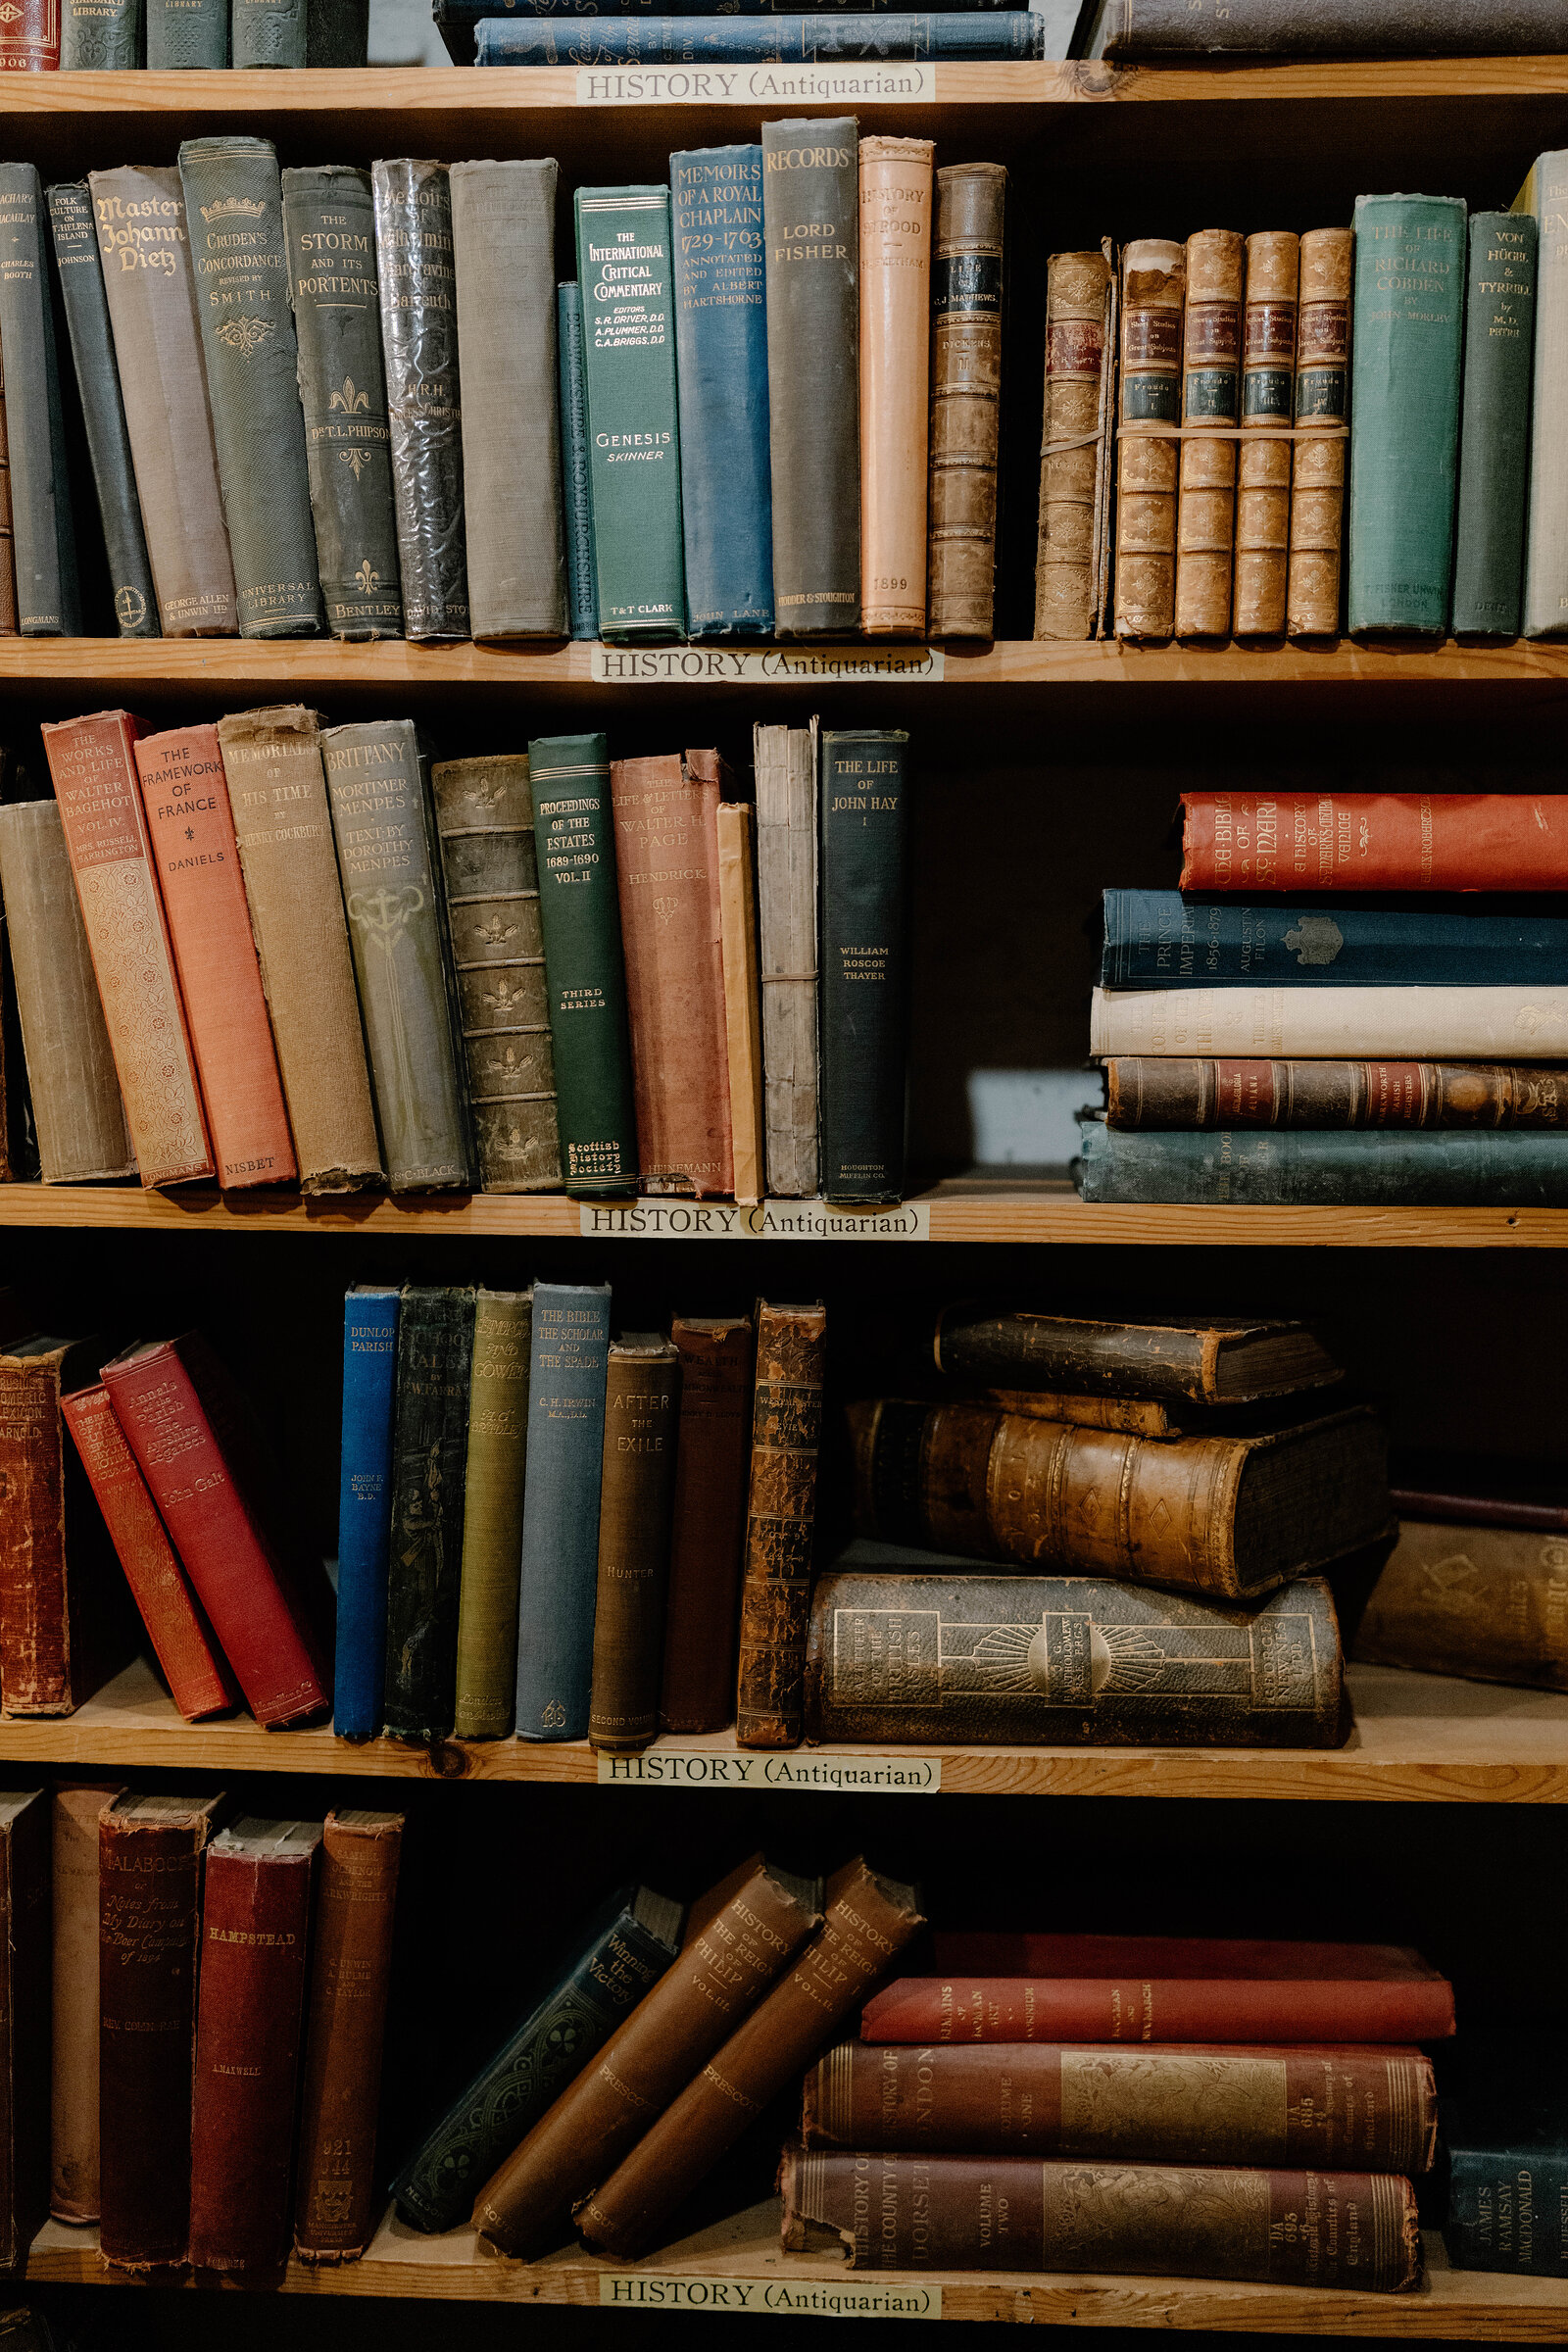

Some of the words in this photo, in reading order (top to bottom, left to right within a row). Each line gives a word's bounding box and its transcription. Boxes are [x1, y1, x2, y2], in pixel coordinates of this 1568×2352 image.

[73, 7, 118, 17] LIBRARY.
[648, 31, 657, 48] BY
[587, 74, 737, 99] HISTORY
[749, 69, 924, 97] (Antiquarian)
[767, 147, 849, 172] RECORDS
[678, 164, 761, 185] MEMOIRS
[861, 188, 924, 204] HISTORY
[97, 196, 183, 221] Master
[321, 216, 346, 224] THE
[680, 208, 761, 228] CHAPLAIN
[58, 232, 88, 241] ISLAND
[102, 221, 185, 254] Johann
[207, 231, 268, 249] CRUDEN'S
[617, 232, 635, 242] THE
[784, 223, 835, 239] LORD
[1372, 225, 1409, 240] THE
[1417, 226, 1451, 242] LIFE
[1495, 231, 1523, 243] VON
[301, 234, 368, 253] STORM
[682, 229, 761, 253] 1729-1763
[59, 255, 95, 267] JOHNSON
[119, 246, 176, 276] Dietz
[589, 243, 663, 262] INTERNATIONAL
[683, 254, 762, 268] ANNOTATED
[775, 245, 847, 262] FISHER
[198, 255, 282, 274] CONCORDANCE
[311, 258, 334, 269] AND
[343, 259, 362, 269] ITS
[1376, 257, 1449, 274] RICHARD
[1504, 268, 1513, 276] &
[602, 265, 653, 281] CRITICAL
[299, 278, 379, 296] PORTENTS
[594, 281, 662, 301] COMMENTARY
[1377, 275, 1444, 292] COBDEN
[684, 294, 762, 310] HARTSHORNE
[1404, 296, 1418, 305] BY
[1500, 302, 1512, 313] by
[1131, 320, 1150, 329] Short
[1153, 320, 1175, 329] Studies
[1135, 383, 1169, 392] Froude
[596, 431, 670, 447] GENESIS
[607, 451, 663, 462] SKINNER
[874, 578, 907, 590] 1899
[165, 597, 195, 612] GEORGE
[197, 594, 229, 607] ALLEN
[334, 605, 400, 618] BENTLEY
[603, 651, 751, 676] HISTORY
[761, 649, 933, 678] (Antiquarian)
[61, 744, 114, 762] WORKS
[161, 748, 190, 762] THE
[326, 741, 406, 772] BRITTANY
[142, 761, 222, 787] FRAMEWORK
[835, 760, 863, 774] THE
[867, 760, 899, 774] LIFE
[65, 781, 124, 802] WALTER
[172, 784, 191, 797] OF
[333, 778, 409, 802] MORTIMER
[858, 780, 874, 790] OF
[242, 791, 267, 807] HIS
[272, 785, 313, 801] TIME
[832, 797, 866, 811] JOHN
[870, 797, 899, 810] HAY
[65, 795, 131, 818] BAGEHOT
[158, 798, 217, 819] FRANCE
[340, 795, 406, 817] MENPES
[540, 798, 600, 815] PROCEEDINGS
[552, 820, 564, 831] OF
[567, 817, 590, 829] THE
[547, 833, 595, 851] ESTATES
[638, 833, 688, 849] PAGE
[1237, 824, 1250, 849] OF
[1308, 827, 1317, 846] OF
[343, 840, 414, 860] DOROTHY
[169, 852, 224, 871] DANIELS
[350, 855, 410, 874] MENPES
[546, 853, 599, 868] 1689-1690
[628, 867, 707, 884] HENDRICK
[1138, 917, 1151, 955] THE
[1157, 906, 1171, 967] PRINCE
[1179, 902, 1195, 976] IMPERIAL
[1240, 907, 1251, 973] AUGUSTIN
[1254, 918, 1266, 960] FILON
[840, 947, 890, 956] WILLIAM
[843, 959, 886, 968] ROSCOE
[844, 971, 886, 980] THAYER
[563, 988, 603, 999] THIRD
[561, 999, 606, 1010] SERIES
[1392, 1081, 1400, 1113] PARISH
[1404, 1074, 1413, 1119] REGISTERS
[225, 1156, 274, 1176] NISBET
[648, 1162, 721, 1175] HEINEMANN
[841, 1163, 885, 1172] HOUGHTON
[591, 1208, 738, 1232] HISTORY
[749, 1206, 918, 1237] (Antiquarian)
[541, 1309, 563, 1323] THE
[566, 1310, 600, 1323] BIBLE
[351, 1326, 395, 1338] DUNLOP
[538, 1327, 559, 1340] THE
[561, 1327, 605, 1341] SCHOLAR
[352, 1341, 394, 1352] PARISH
[558, 1343, 580, 1352] AND
[539, 1356, 561, 1369] THE
[564, 1356, 600, 1369] SPADE
[127, 1380, 177, 1409] Annals
[613, 1394, 669, 1409] AFTER
[137, 1399, 185, 1427] Parish
[631, 1420, 654, 1429] THE
[617, 1437, 663, 1452] EXILE
[165, 1481, 194, 1509] John
[195, 1470, 225, 1492] Galt
[352, 1482, 381, 1492] BAYNE
[358, 1492, 376, 1501] B.D.
[608, 1566, 655, 1580] HUNTER
[906, 1631, 921, 1690] ISLES
[1261, 1620, 1273, 1701] GEORGE
[1276, 1620, 1288, 1698] NEWNES
[610, 1757, 755, 1782] HISTORY
[764, 1761, 932, 1787] (Antiquarian)
[107, 1894, 143, 1911] Notes
[146, 1897, 180, 1912] from
[209, 1927, 296, 1946] HAMPSTEAD
[731, 1899, 792, 1956] HISTORY
[835, 1899, 900, 1956] HISTORY
[742, 1932, 759, 1947] OF
[847, 1933, 862, 1947] OF
[608, 1933, 655, 1983] Winning
[726, 1953, 743, 1967] OF
[831, 1953, 848, 1967] OF
[610, 1959, 633, 1984] the
[589, 1958, 635, 2005] Victory
[1300, 2097, 1314, 2129] 685
[911, 2164, 931, 2262] DORSET
[980, 2182, 993, 2248] VOLUME
[998, 2197, 1009, 2234] TWO
[1478, 2186, 1493, 2247] JAMES
[1498, 2180, 1512, 2251] RAMSAY
[1518, 2169, 1533, 2264] MACDONALD
[1271, 2222, 1285, 2241] DA
[1285, 2211, 1298, 2243] 693
[611, 2279, 755, 2306] HISTORY
[764, 2288, 930, 2314] (Antiquarian)
